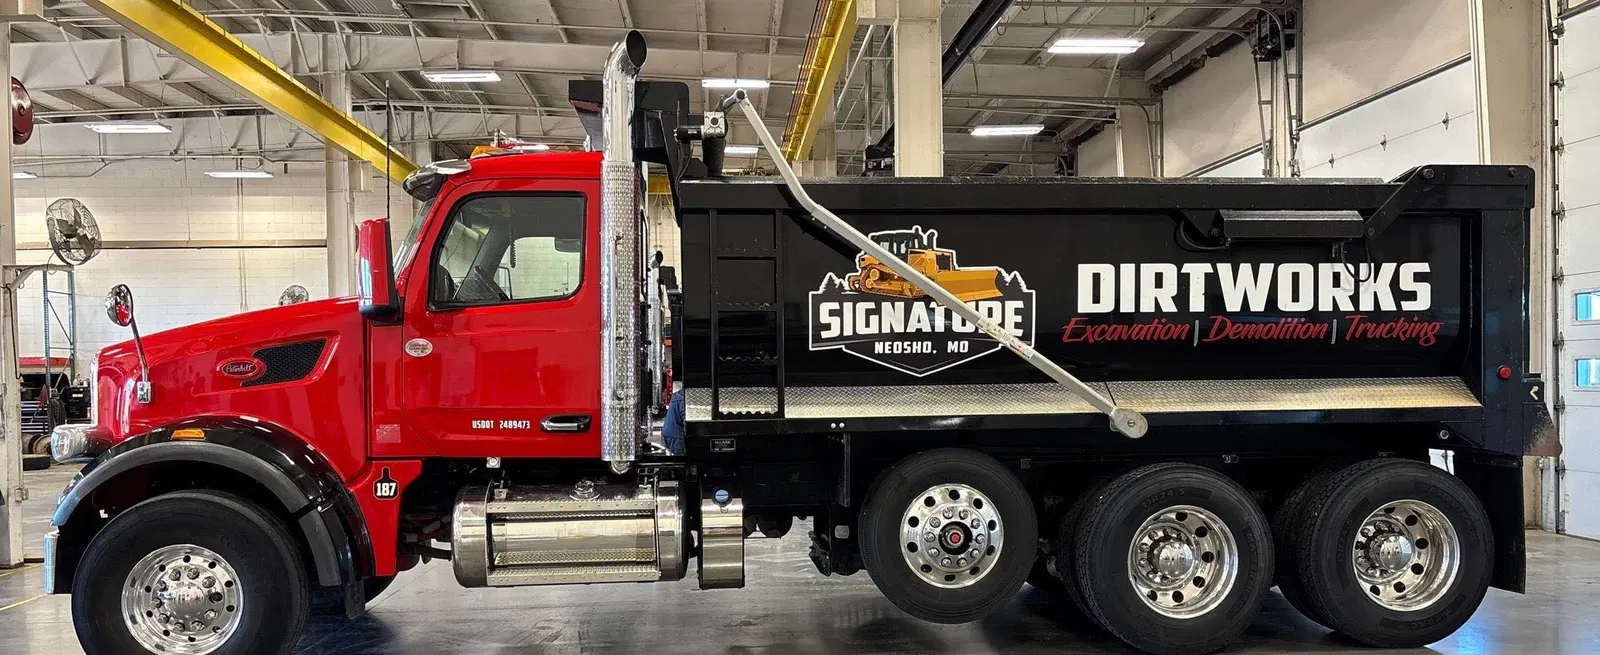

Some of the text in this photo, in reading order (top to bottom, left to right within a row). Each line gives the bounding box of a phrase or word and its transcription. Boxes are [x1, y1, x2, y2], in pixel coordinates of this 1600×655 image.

[1077, 262, 1432, 313] DIRTWORKS
[819, 300, 1025, 339] SIGNATURE
[1062, 317, 1191, 344] Excavation
[1201, 315, 1329, 343] Demolition
[1345, 315, 1444, 347] Trucking
[874, 340, 969, 355] NEOSHO, MO
[472, 420, 531, 429] USDOT 2489473
[376, 482, 397, 497] 187
